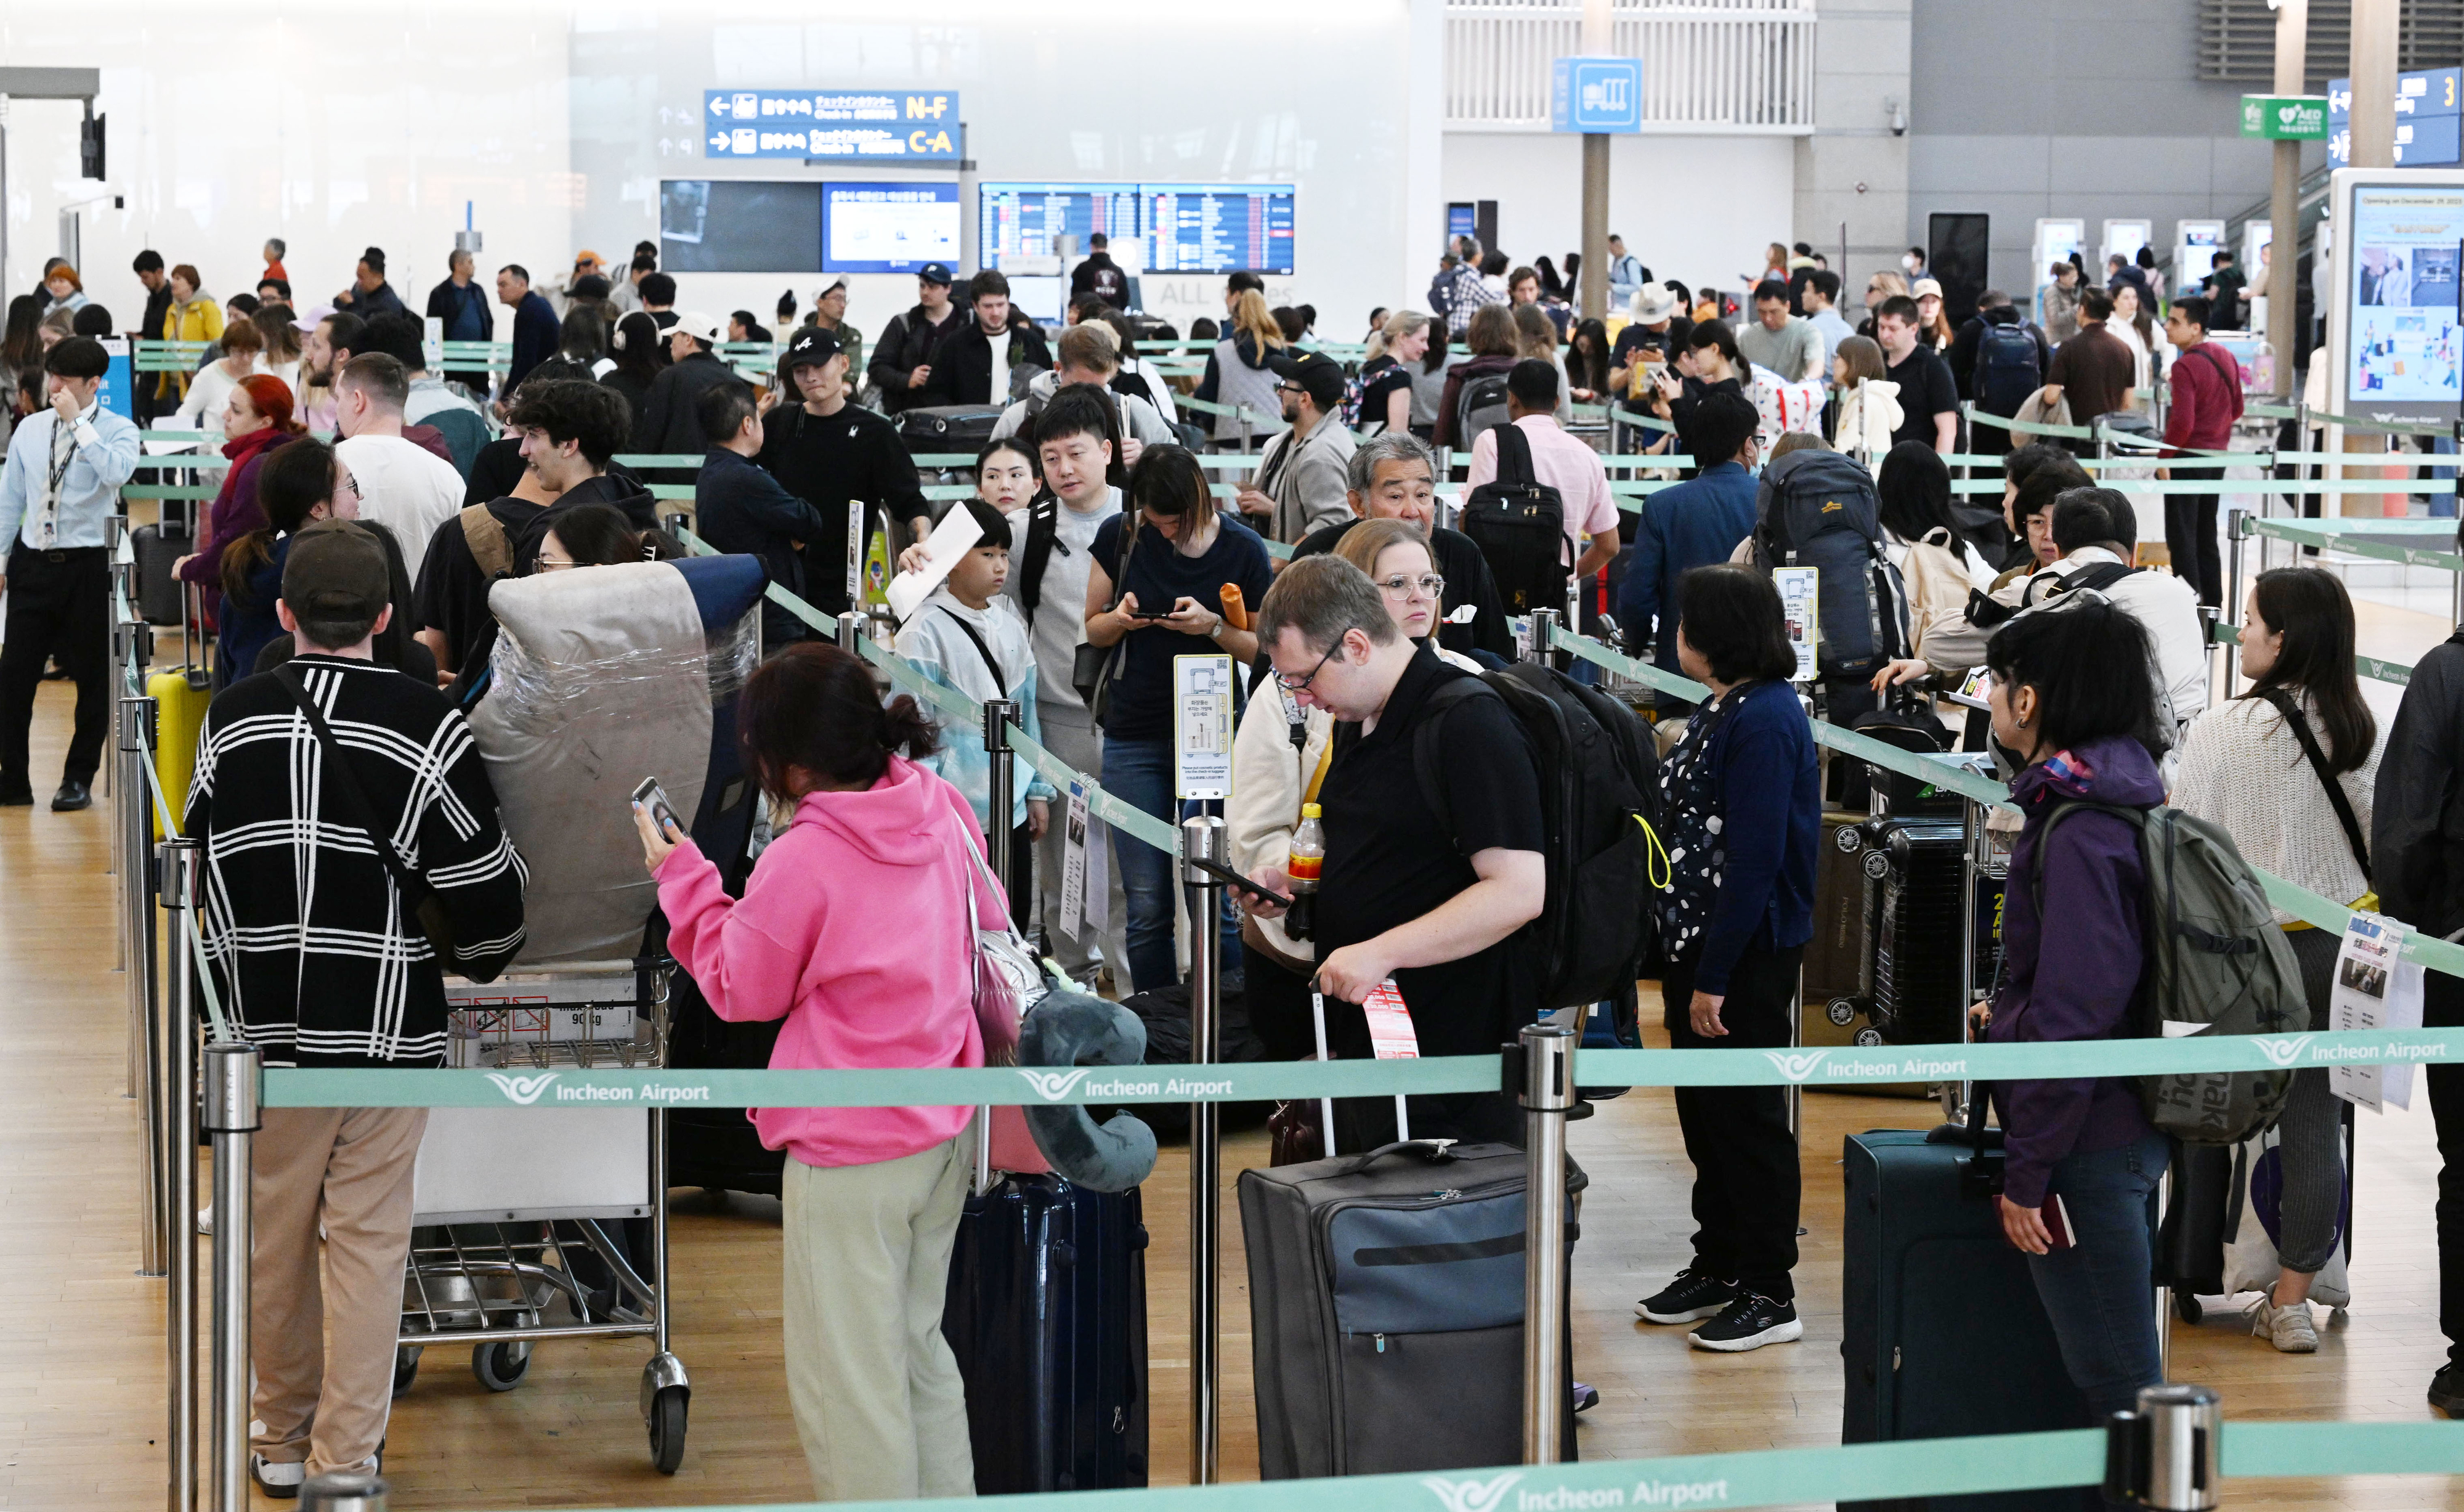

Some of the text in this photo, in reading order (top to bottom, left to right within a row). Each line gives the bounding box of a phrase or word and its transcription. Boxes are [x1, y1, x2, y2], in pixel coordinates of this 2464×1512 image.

[2444, 76, 2455, 107] 3
[907, 96, 947, 119] N-F
[909, 131, 953, 153] C-A
[1161, 282, 1209, 304] ALL
[2383, 669, 2399, 681] Incheon
[2312, 1042, 2446, 1060] Incheon Airport
[1827, 1059, 1968, 1078] Incheon Airport
[556, 1083, 710, 1104] Incheon Airport
[1085, 1078, 1234, 1098] Incheon Airport
[1517, 1478, 1728, 1511] Incheon Airport
